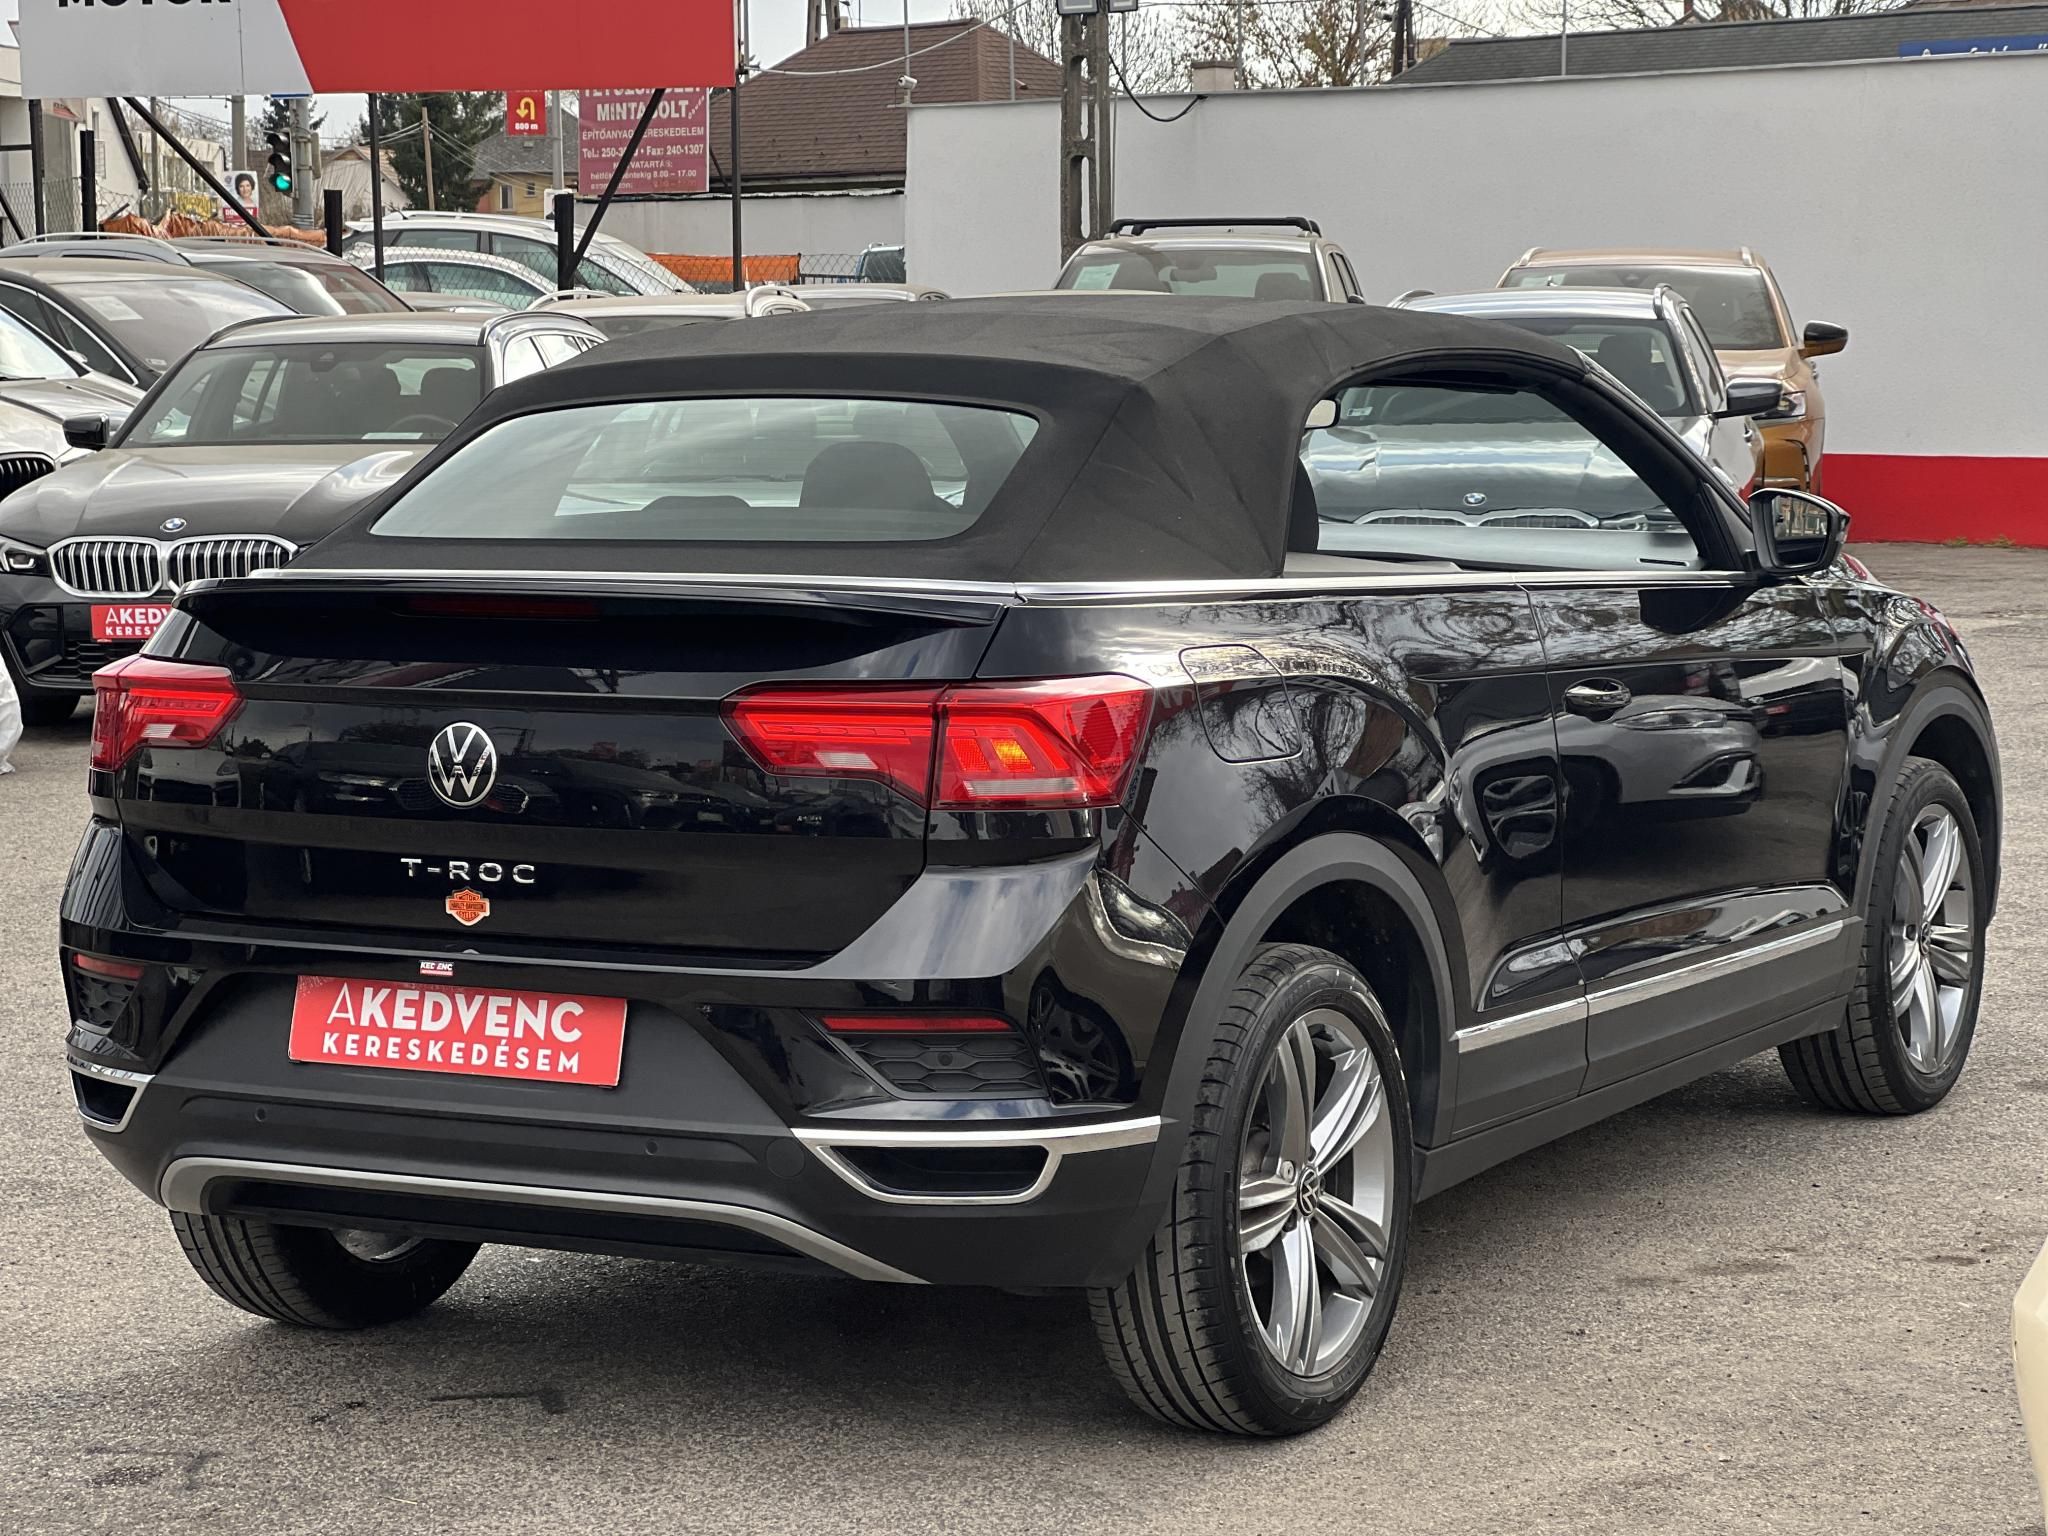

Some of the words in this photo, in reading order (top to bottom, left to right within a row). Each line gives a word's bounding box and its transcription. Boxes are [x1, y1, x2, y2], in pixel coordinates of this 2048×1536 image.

[106, 626, 157, 636] KERES
[400, 857, 535, 884] T-ROC
[327, 983, 584, 1043] AKEDVENC
[322, 1031, 579, 1074] KERESKEDÉSEM
